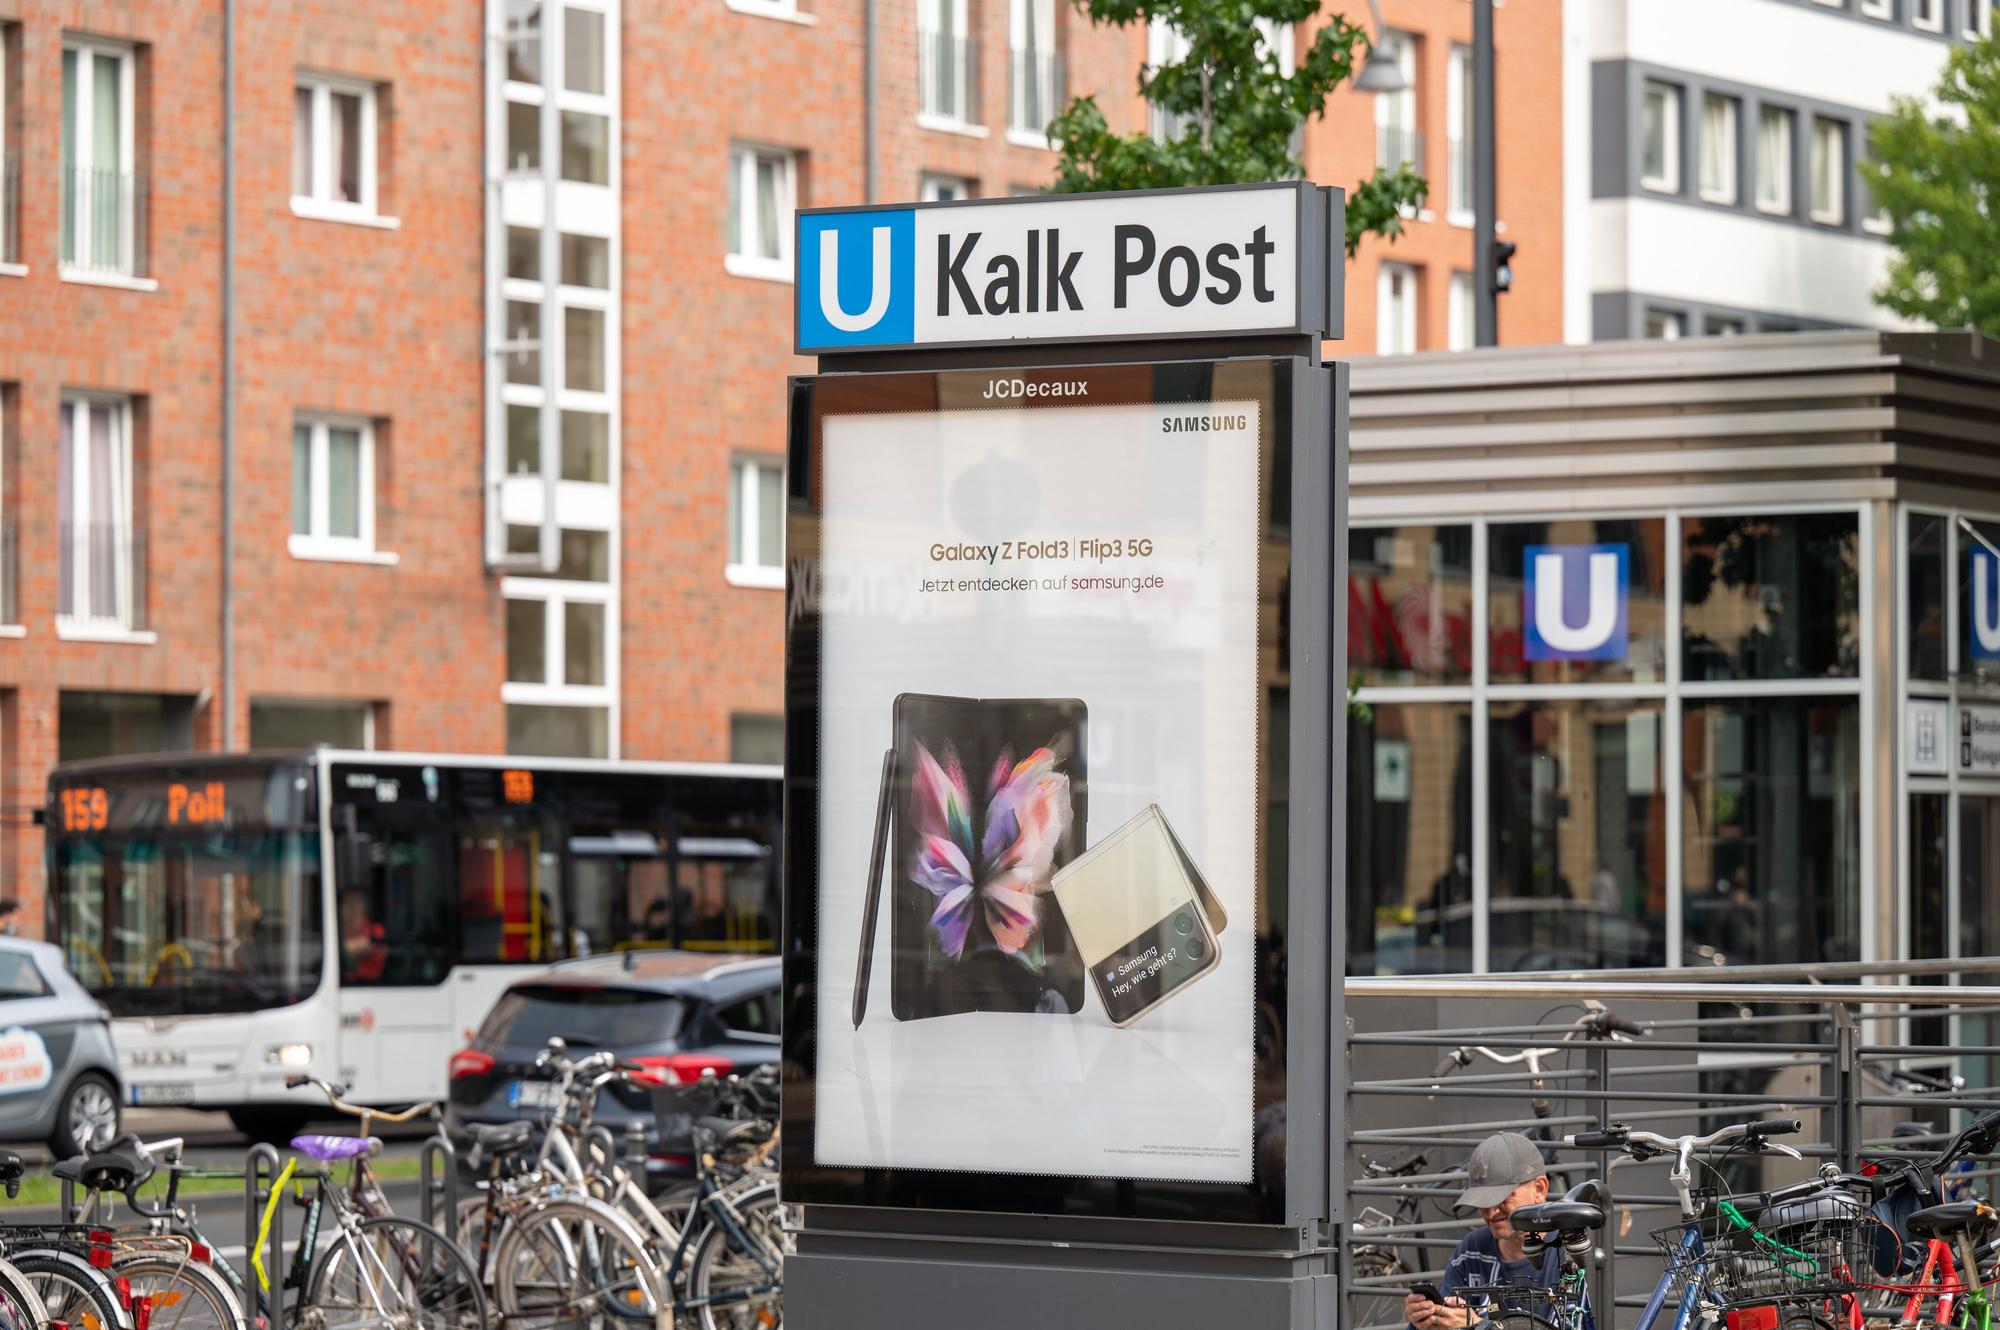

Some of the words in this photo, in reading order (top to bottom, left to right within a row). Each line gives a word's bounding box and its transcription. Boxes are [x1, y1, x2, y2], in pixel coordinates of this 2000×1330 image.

[819, 227, 891, 332] U
[936, 228, 1083, 317] Kalk
[1113, 224, 1275, 309] Post
[983, 378, 1088, 400] JCDecaux
[1162, 415, 1247, 434] SAMSUNG
[930, 542, 999, 564] Galaxy
[1001, 542, 1012, 560] Z
[1017, 540, 1069, 560] Fold3
[1080, 539, 1123, 564] Flip3
[1127, 538, 1153, 557] 5G
[919, 577, 955, 593] Jetzt
[958, 576, 1038, 591] entdecken
[1042, 575, 1068, 590] auf
[1071, 574, 1164, 593] samsung.de
[1535, 553, 1618, 652] U
[61, 788, 108, 832] 159
[168, 782, 225, 823] Poll
[1111, 982, 1132, 997] Hey,
[1131, 971, 1147, 985] wie
[1147, 948, 1177, 975] geht's?
[1118, 945, 1157, 975] Samsung
[1302, 1228, 1307, 1240] E
